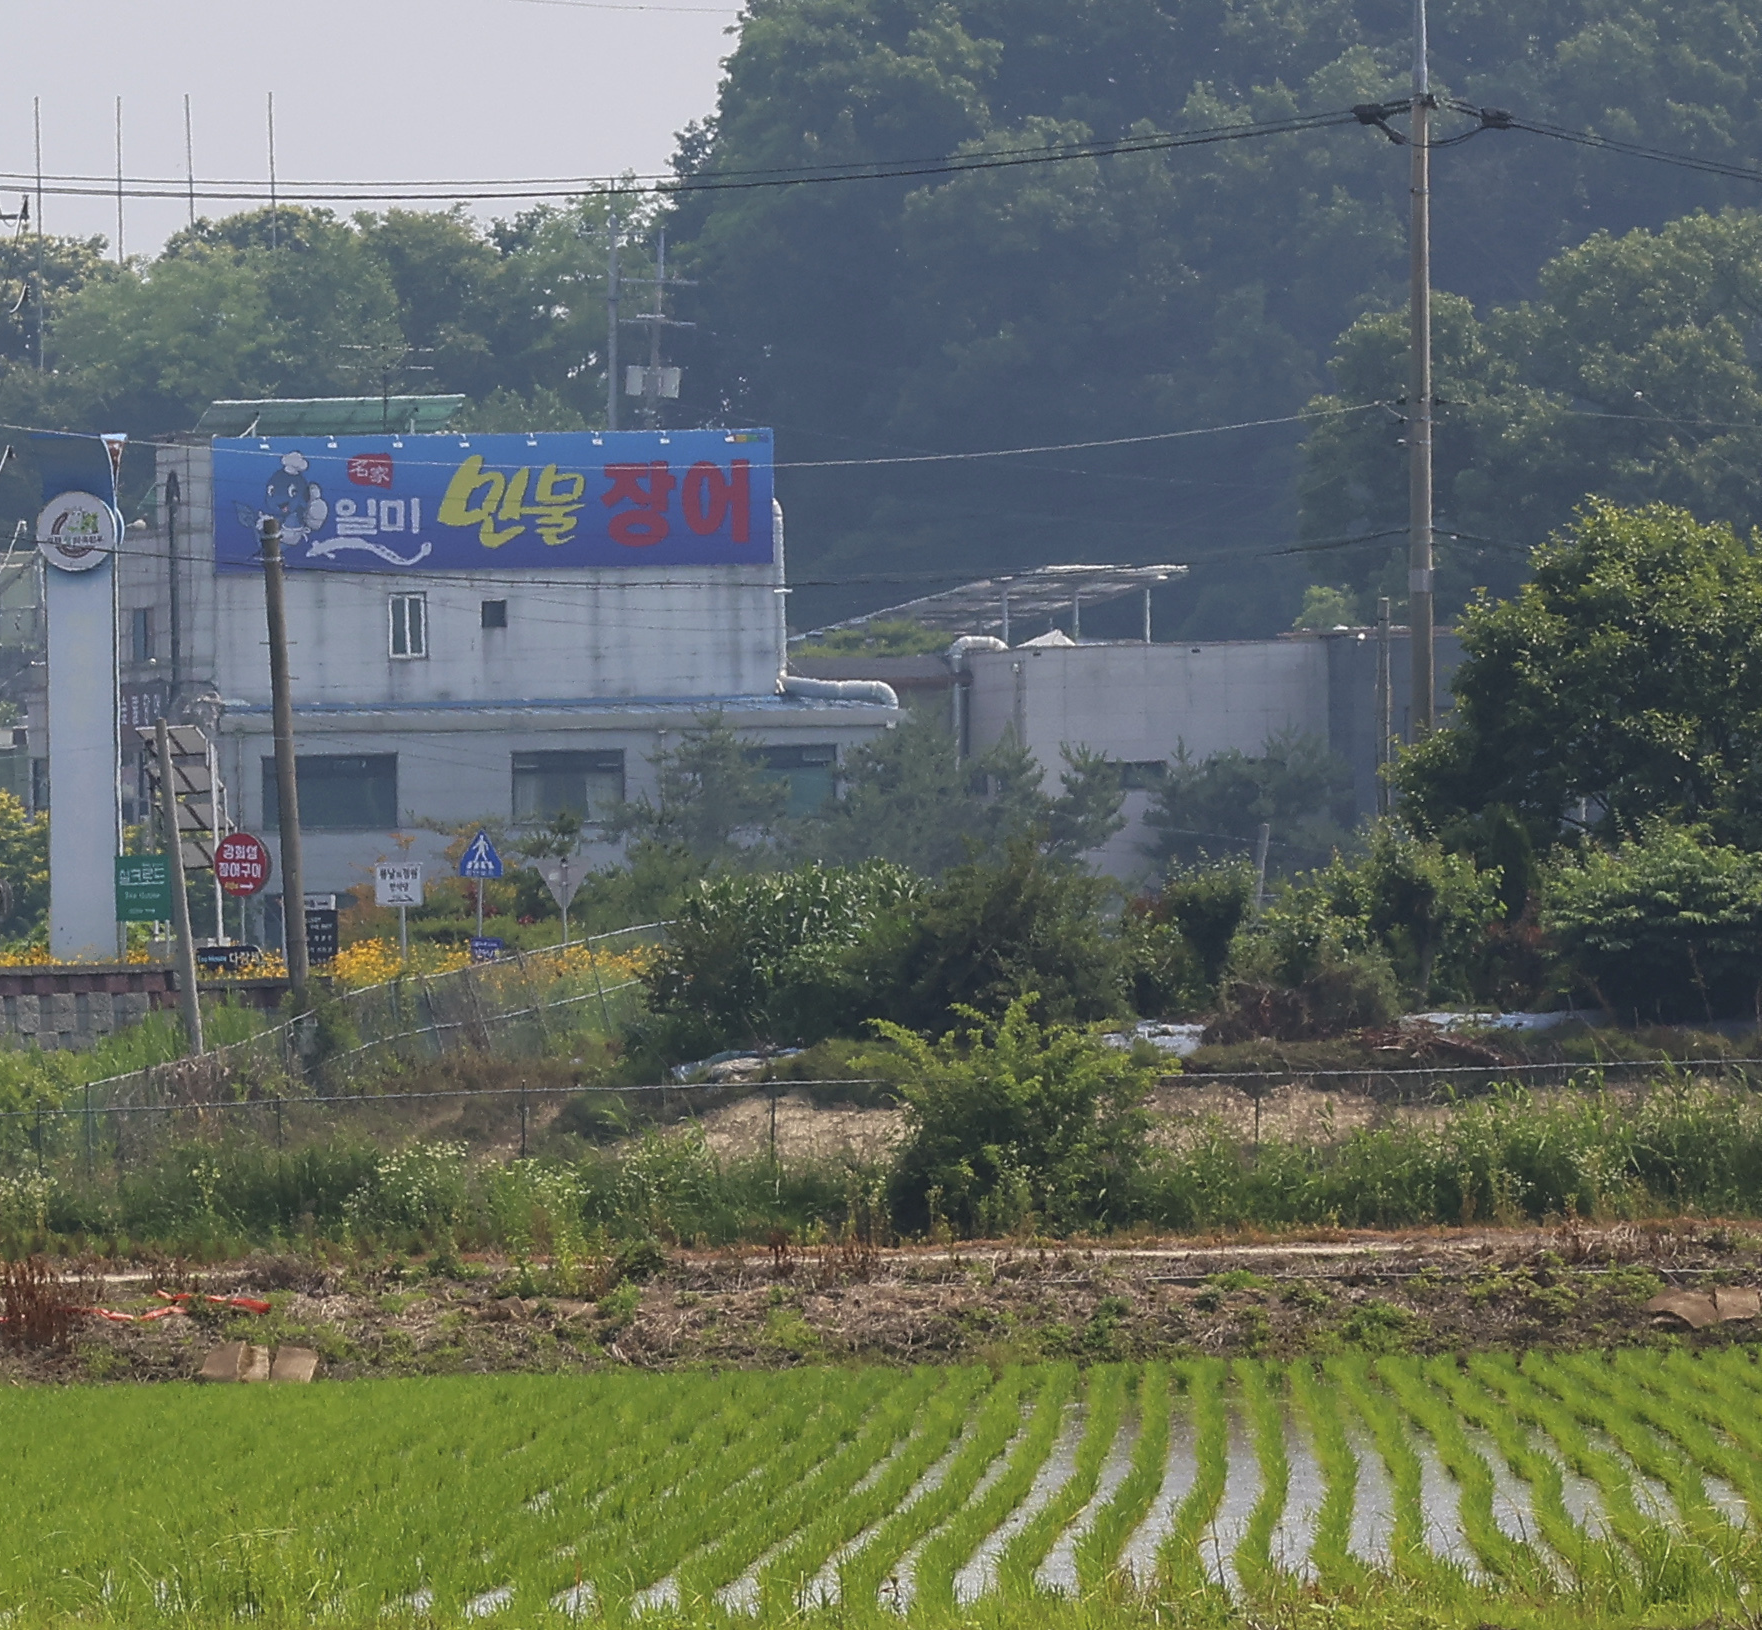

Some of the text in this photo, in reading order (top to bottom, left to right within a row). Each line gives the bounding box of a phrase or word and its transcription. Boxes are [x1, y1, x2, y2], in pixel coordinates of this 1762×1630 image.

[335, 454, 751, 548] 일미 민물 장어
